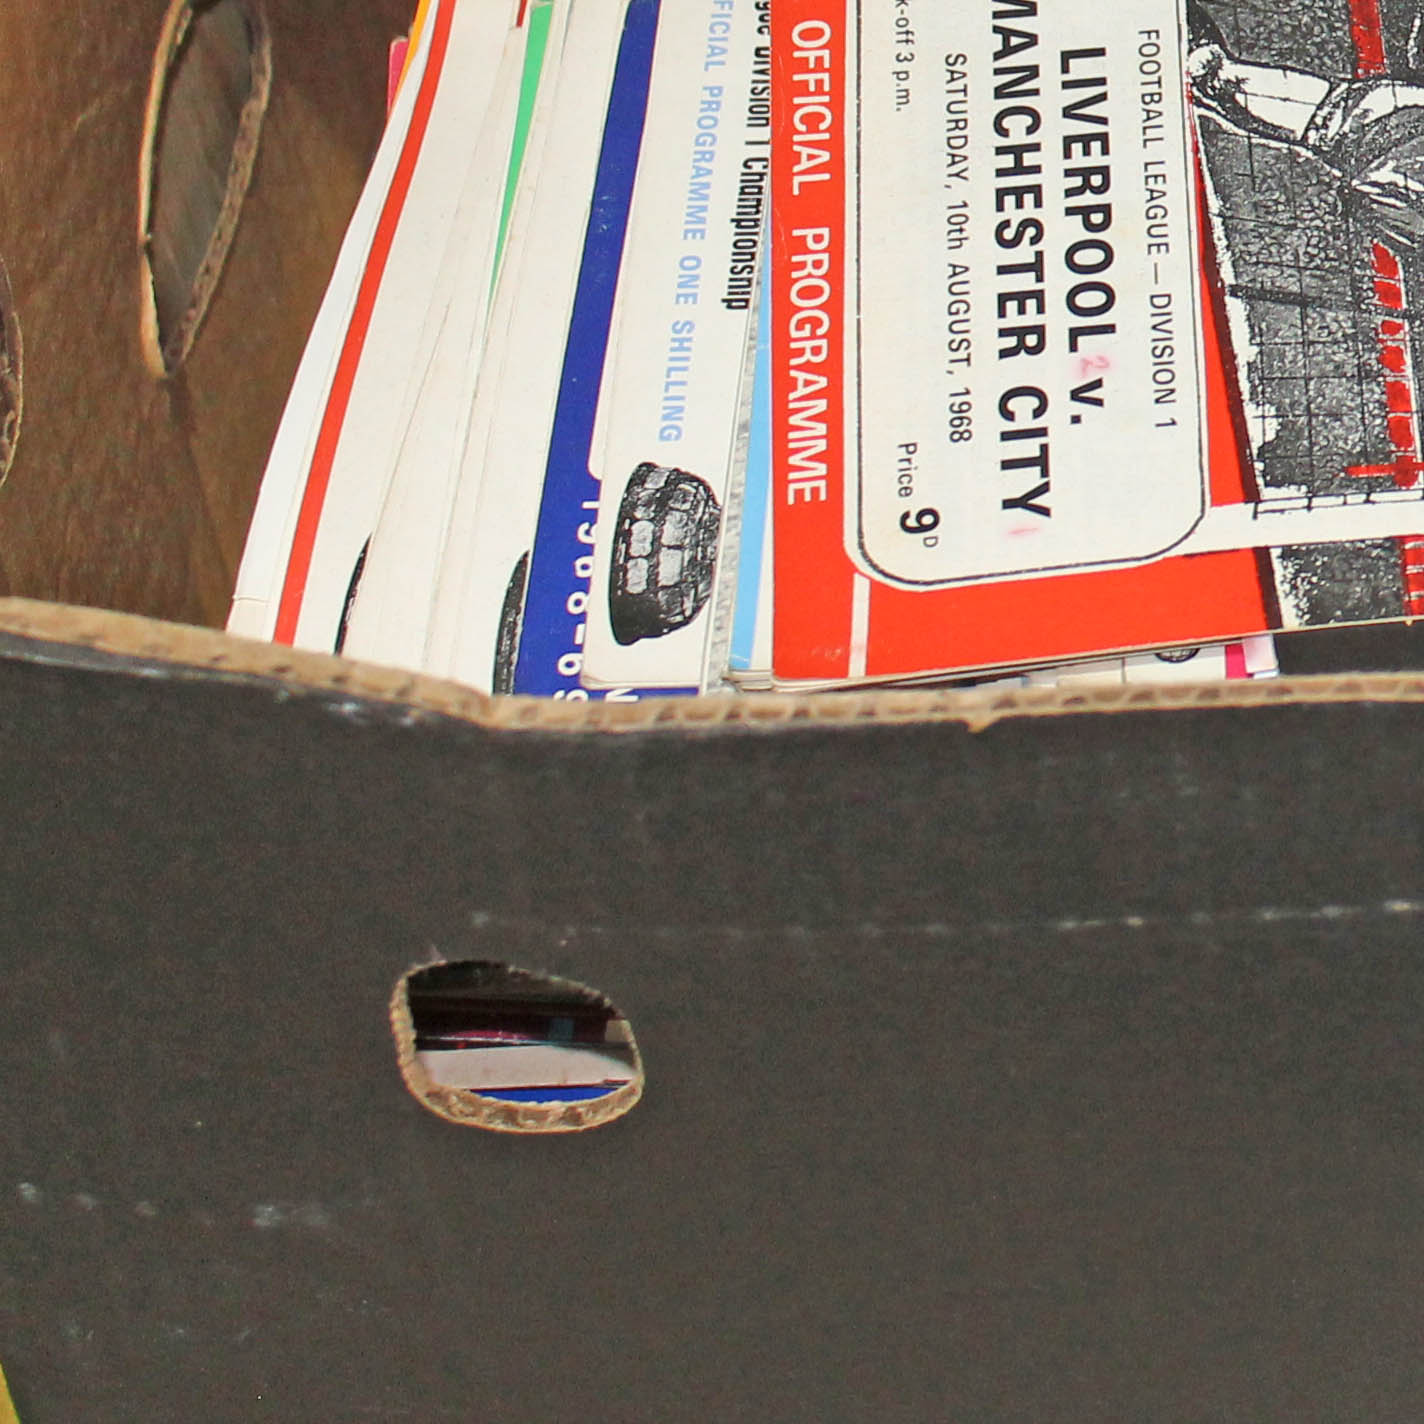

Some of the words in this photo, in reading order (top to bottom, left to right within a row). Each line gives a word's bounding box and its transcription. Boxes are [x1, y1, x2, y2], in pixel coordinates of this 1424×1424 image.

[791, 19, 833, 196] OFFICIAL
[892, 69, 911, 113] p.m.
[896, 51, 915, 64] 3
[1138, 29, 1165, 149] FOOTBALL
[682, 85, 724, 241] PROGRAMME
[944, 52, 970, 189] SATURDAY,
[721, 157, 770, 310] Championship
[946, 200, 971, 251] 10th
[1060, 46, 1117, 353] LIVERPOOL
[1144, 161, 1170, 257] LEAGUE
[675, 255, 702, 305] ONE
[946, 263, 972, 376] AUGUST,
[658, 319, 696, 443] SHILLING
[787, 227, 831, 505] PROGRAMME
[1069, 377, 1105, 425] v.
[1149, 293, 1178, 405] DIVISION
[897, 442, 920, 498] Price
[949, 387, 973, 444] 1968
[998, 386, 1052, 519] CITY
[1154, 417, 1178, 428] 1
